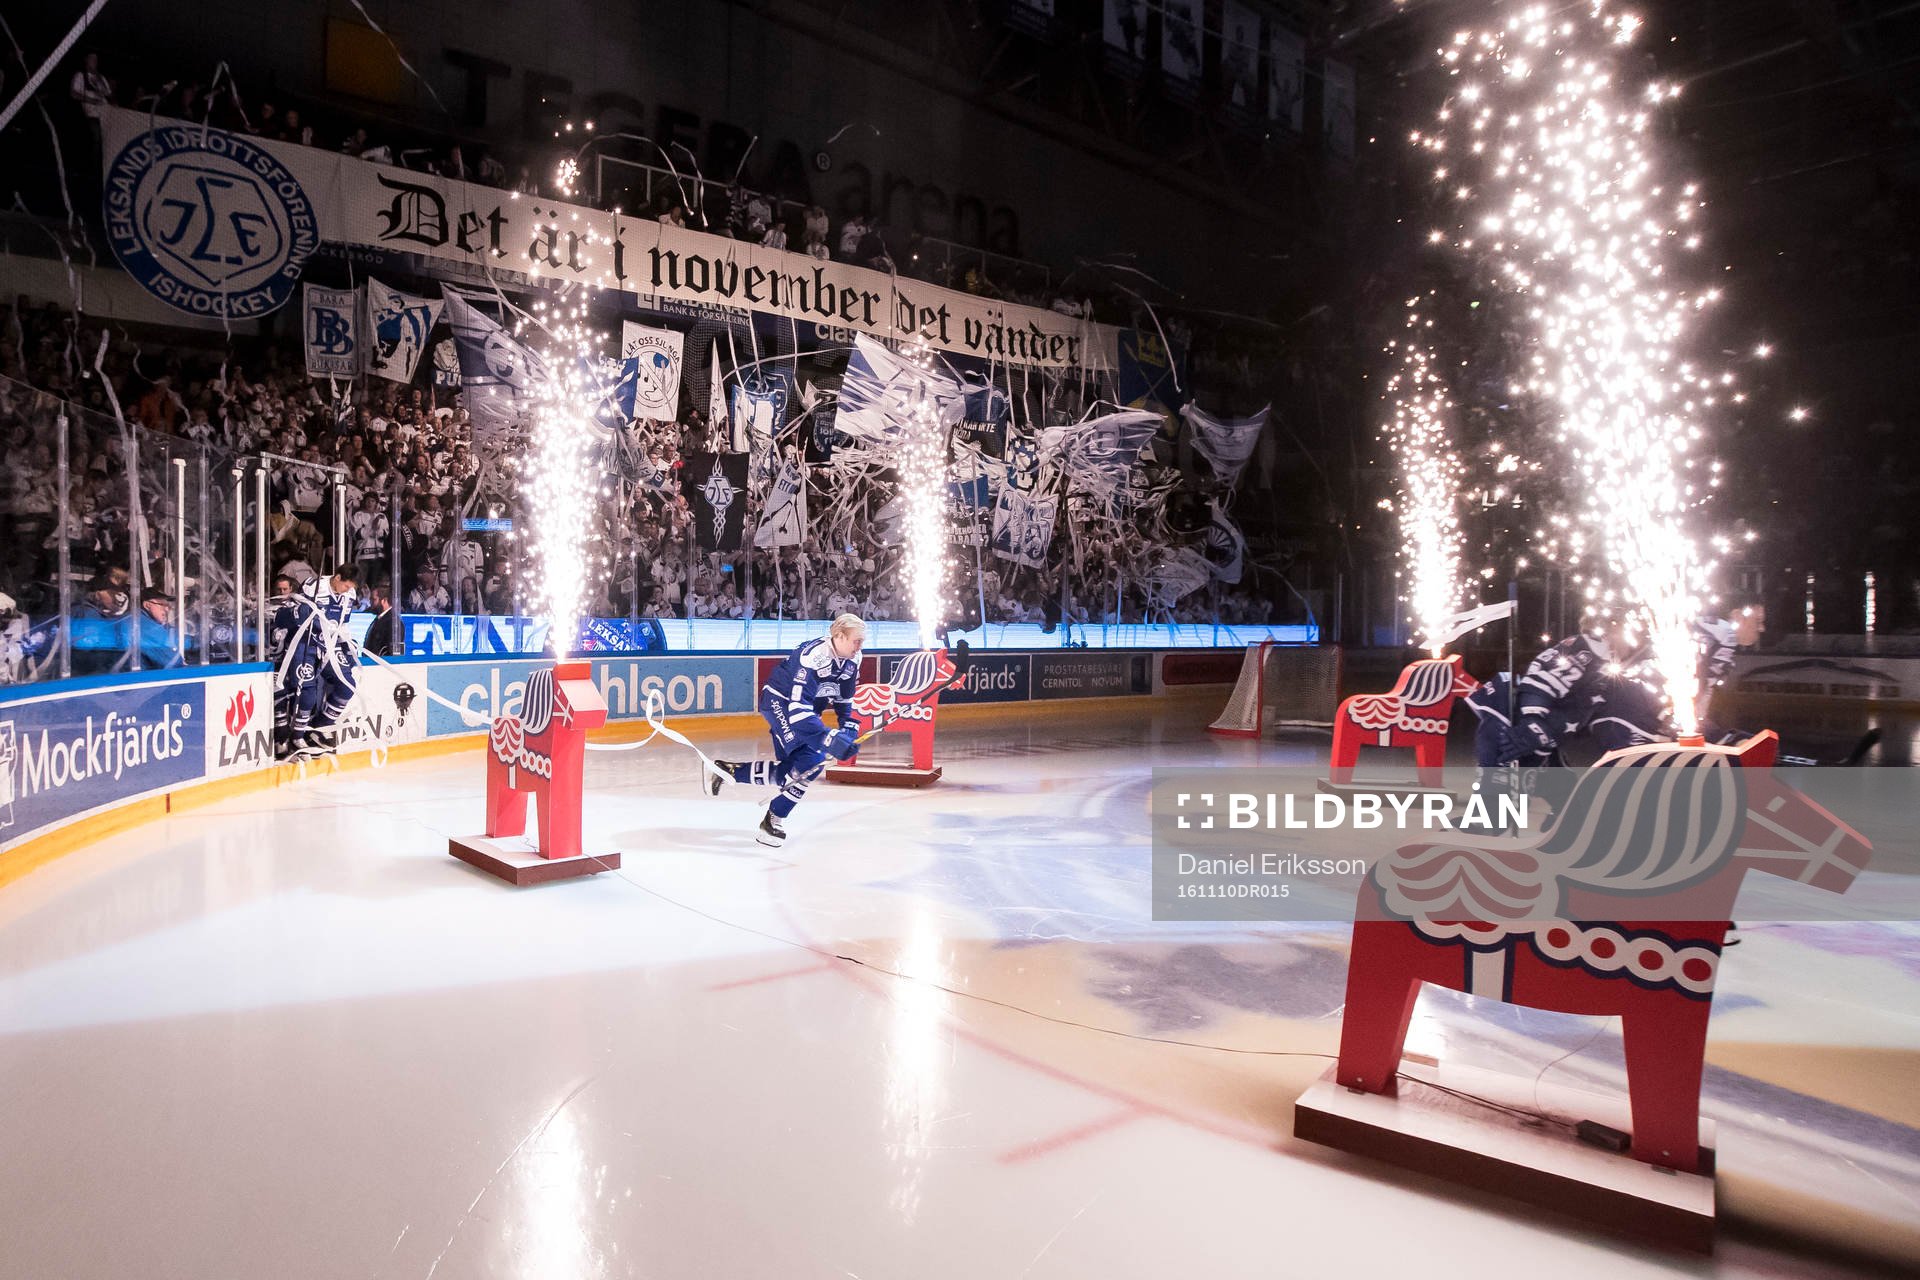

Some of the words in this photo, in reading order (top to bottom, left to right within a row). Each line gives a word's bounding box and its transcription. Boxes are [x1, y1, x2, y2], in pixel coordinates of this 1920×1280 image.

[109, 138, 164, 255] LEKSANDS
[163, 129, 314, 280] IDROTTSFÖRENING
[377, 172, 509, 259] Det
[528, 206, 590, 273] är
[612, 226, 628, 281] i
[648, 247, 881, 327] november
[893, 285, 952, 345] det
[963, 310, 1081, 365] vänder
[148, 272, 276, 315] ISHOCKEY
[663, 304, 688, 316] BANK
[638, 336, 654, 346] OSS
[587, 618, 642, 651] LEKSA
[459, 667, 526, 727] cla
[600, 663, 723, 714] hlson
[1042, 677, 1083, 689] CERNITOL
[1091, 675, 1123, 688] NOVUM
